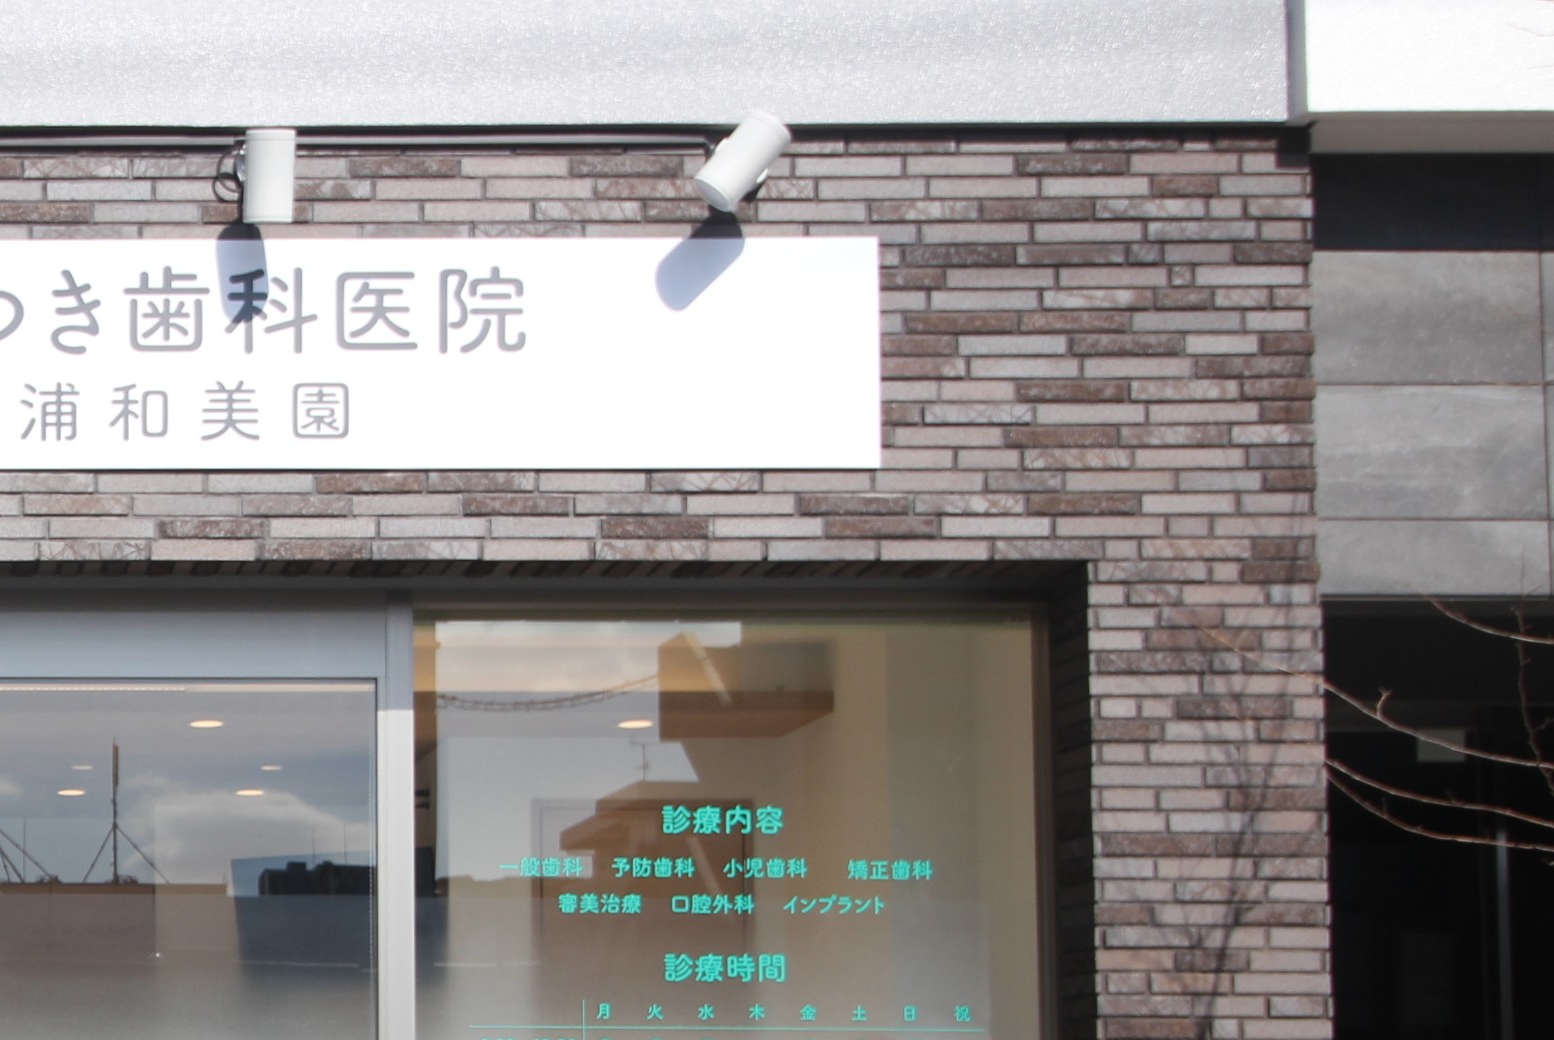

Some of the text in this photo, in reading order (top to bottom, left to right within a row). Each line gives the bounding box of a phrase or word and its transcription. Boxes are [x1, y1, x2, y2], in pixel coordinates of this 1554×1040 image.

[20, 380, 350, 442] 浦和美園
[661, 804, 784, 835] 診療内容
[498, 857, 934, 881] 一般歯科 予防歯科 小児歯科 矯正歯科
[558, 892, 886, 916] 審美治療 口腔外科 インプラント
[663, 953, 787, 983] 診療時間
[596, 1003, 972, 1023] 月 火 水 木 金 土 日 祝
